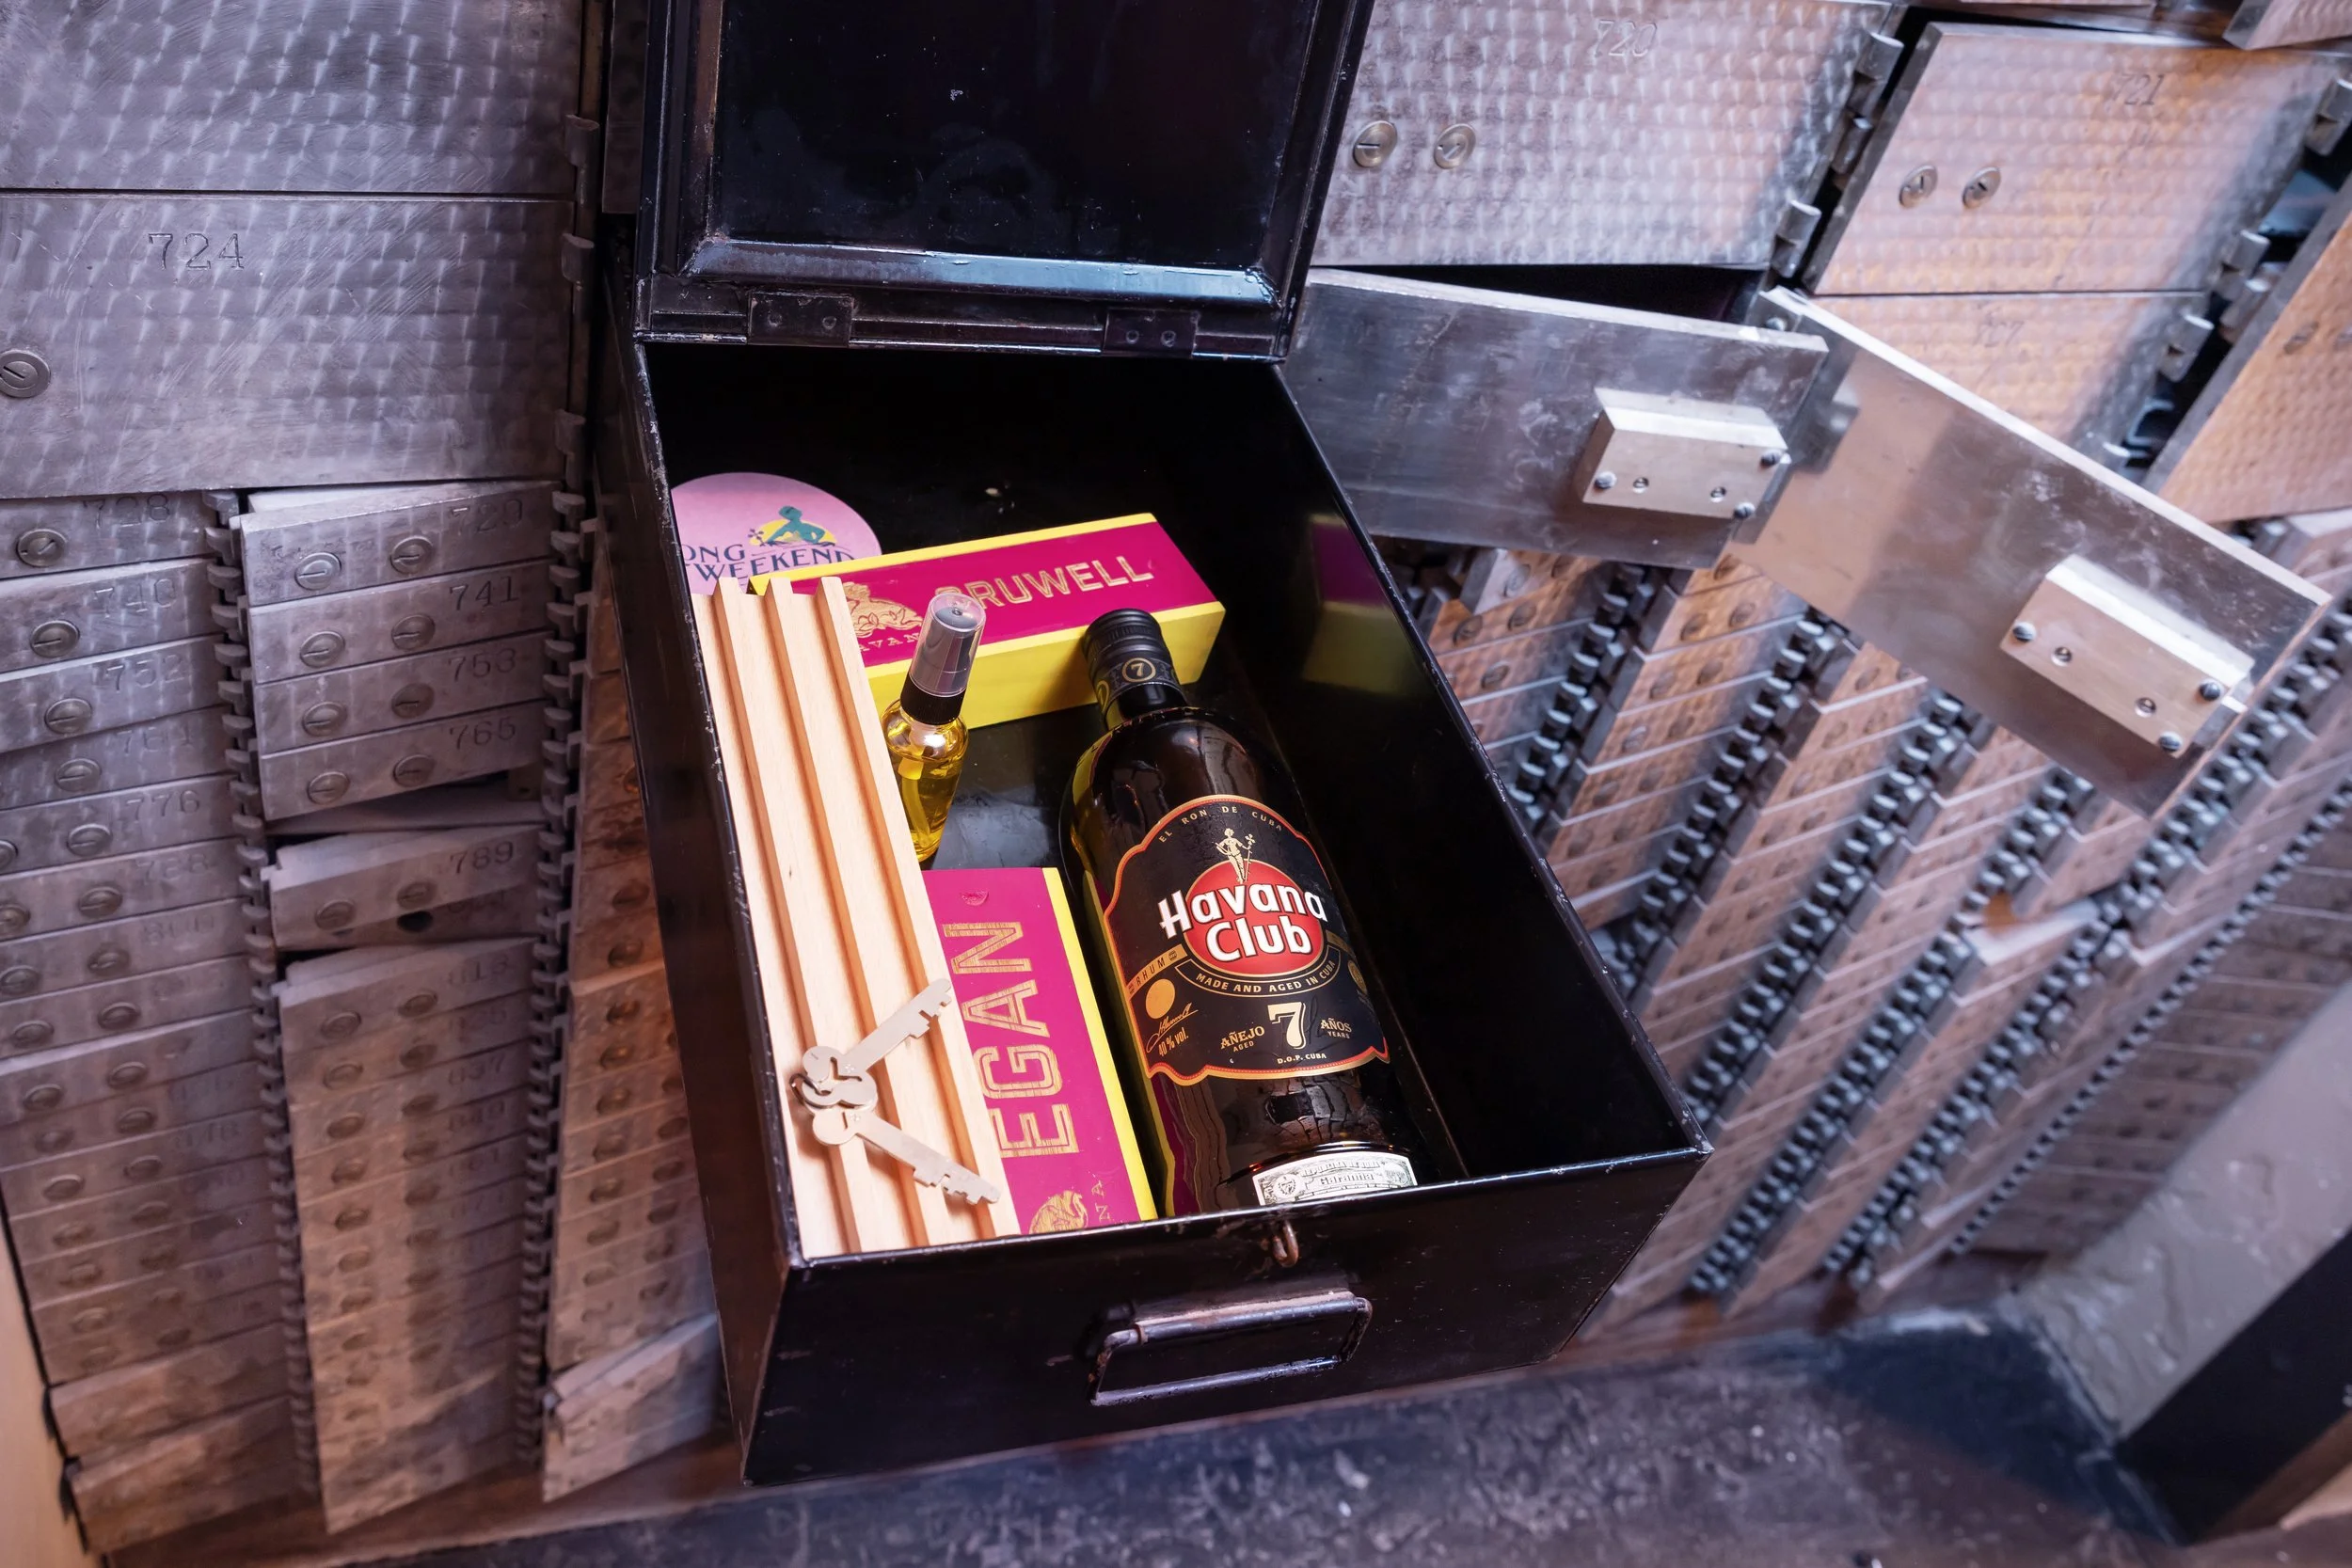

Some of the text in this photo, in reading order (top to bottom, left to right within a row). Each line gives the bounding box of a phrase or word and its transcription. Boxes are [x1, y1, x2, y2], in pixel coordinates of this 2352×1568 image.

[1593, 19, 1658, 56] 720
[148, 232, 245, 270] 724
[82, 493, 170, 530] 728
[449, 499, 524, 536] 729
[93, 578, 178, 618] 740
[449, 576, 520, 611] 741
[934, 556, 1154, 610] RUWELL
[105, 654, 186, 693] 752
[447, 648, 516, 683] 753
[1130, 662, 1145, 677] 7
[449, 715, 516, 751] 765
[125, 789, 200, 824] 776
[1158, 831, 1173, 843] EL
[1181, 809, 1207, 825] RON
[1251, 811, 1282, 832] CUBA
[450, 841, 514, 875] 789
[1157, 882, 1328, 939] Havana
[1206, 915, 1312, 961] Club
[1136, 957, 1166, 987] RHUM
[1196, 959, 1336, 993] MADE AND AGED IN CUBA
[942, 921, 1081, 1159] EGAN
[1220, 1025, 1265, 1050] AÑEJO
[1267, 1002, 1307, 1050] 7
[1320, 1017, 1352, 1033] AÑOS
[1232, 1040, 1254, 1053] AGED
[1277, 1054, 1303, 1064] D.O.P.
